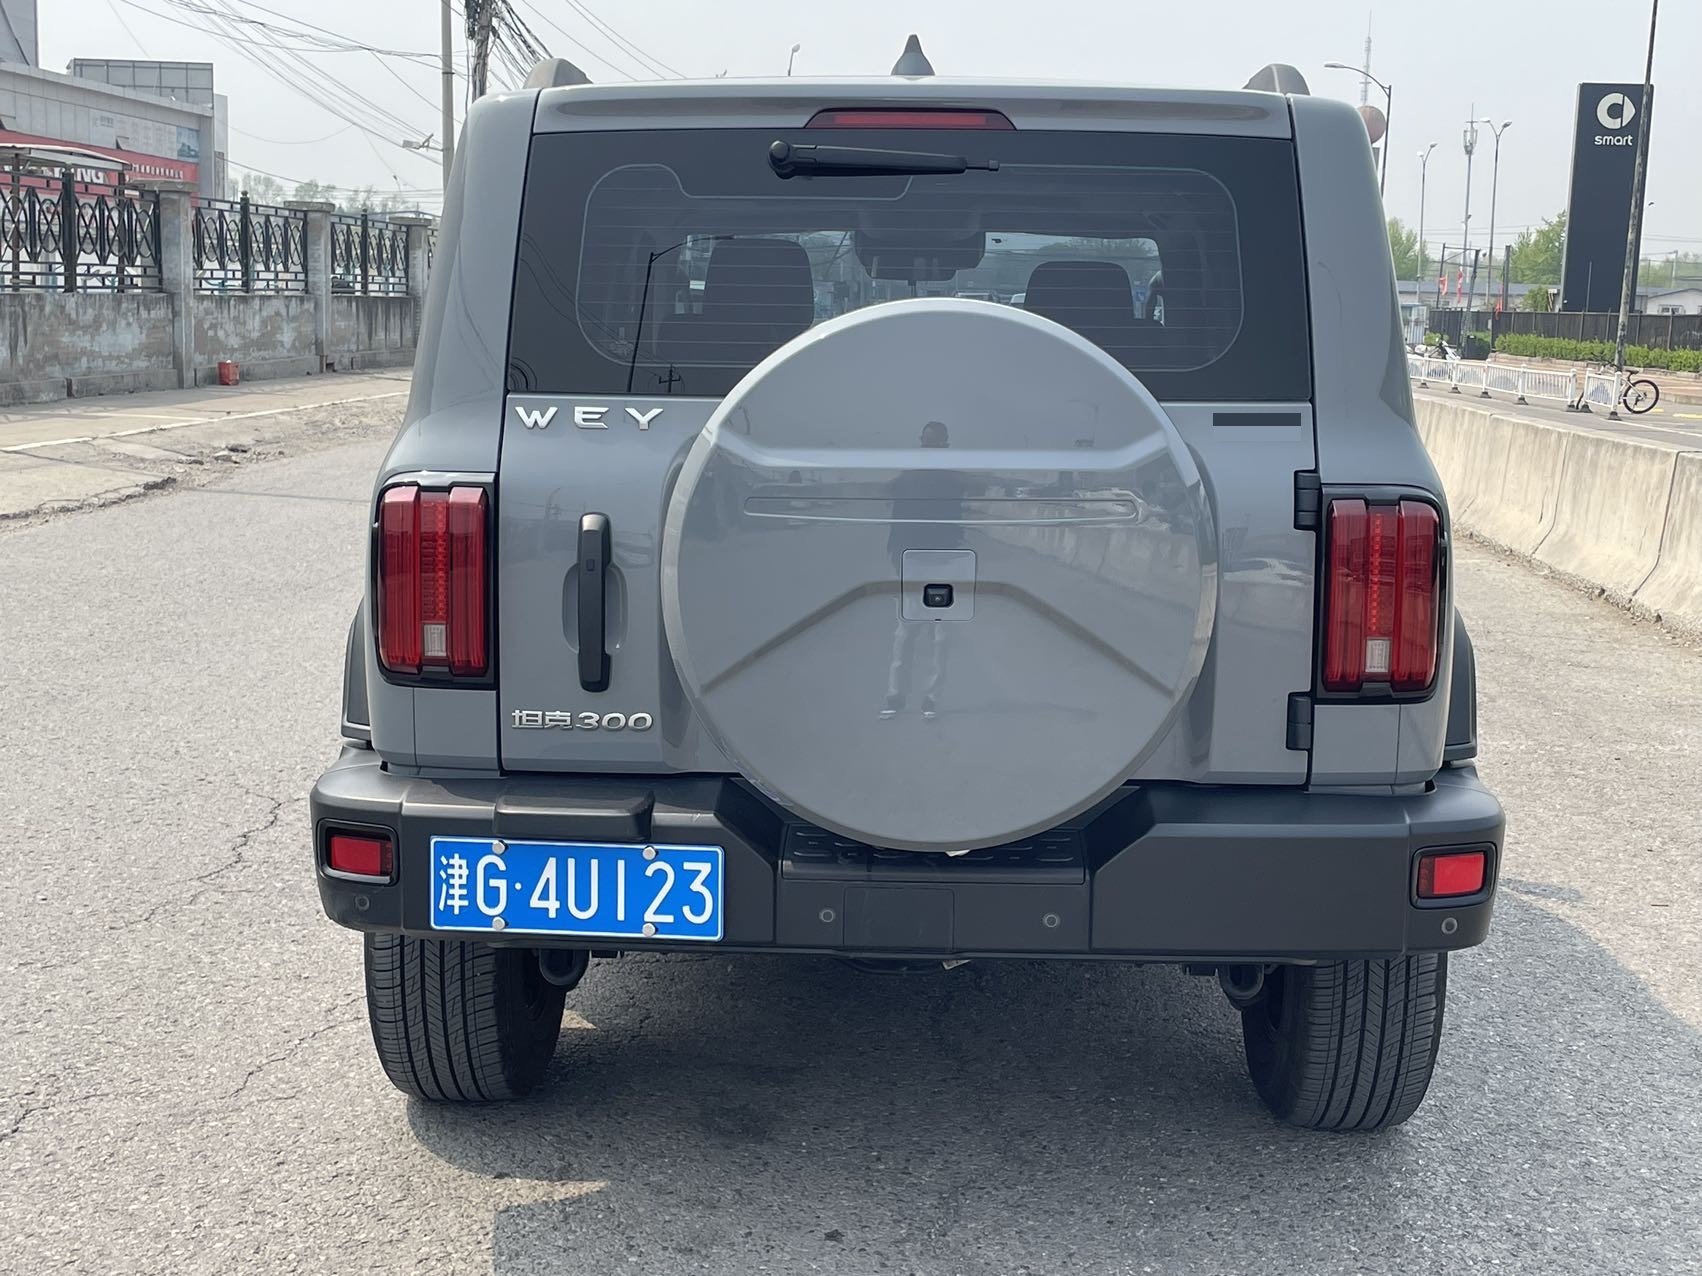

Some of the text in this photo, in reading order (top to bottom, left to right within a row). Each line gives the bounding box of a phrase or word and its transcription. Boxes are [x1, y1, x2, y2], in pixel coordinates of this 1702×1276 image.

[1594, 134, 1633, 146] smart
[514, 406, 664, 430] WEY
[511, 709, 653, 731] 坦克300
